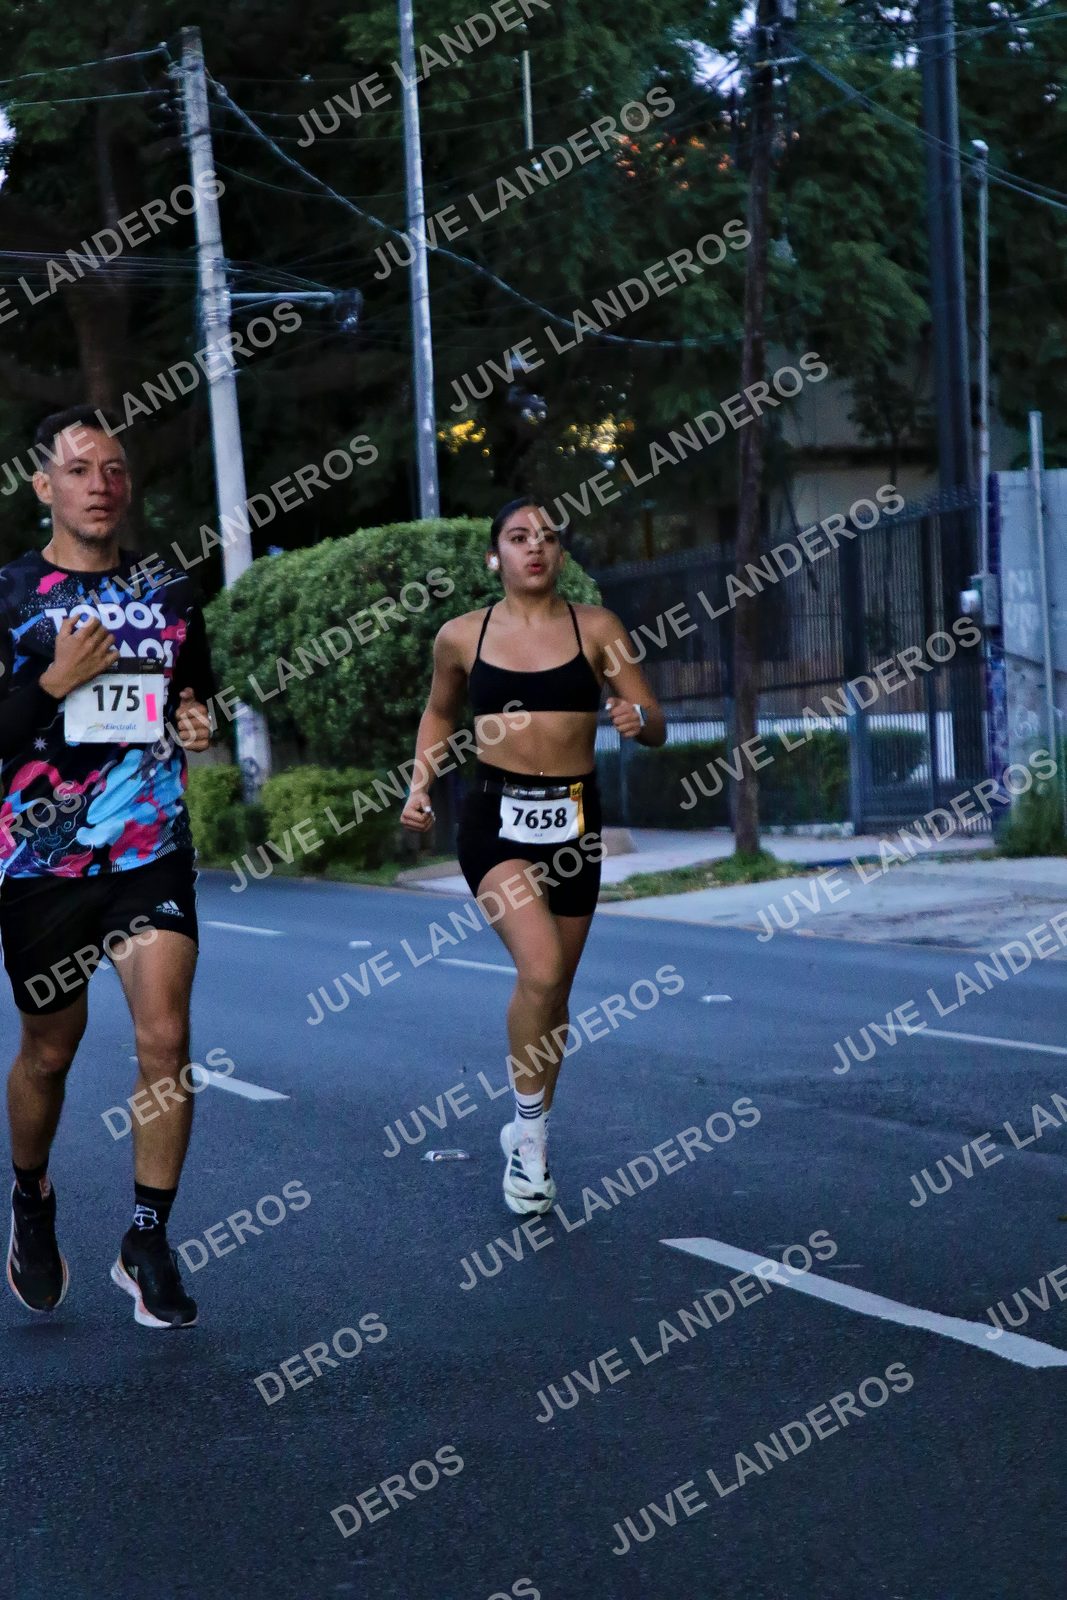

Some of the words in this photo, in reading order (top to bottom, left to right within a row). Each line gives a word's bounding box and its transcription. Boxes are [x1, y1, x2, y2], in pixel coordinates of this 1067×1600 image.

[45, 602, 166, 633] TODOS
[92, 685, 140, 711] 175
[512, 806, 567, 829] 7658
